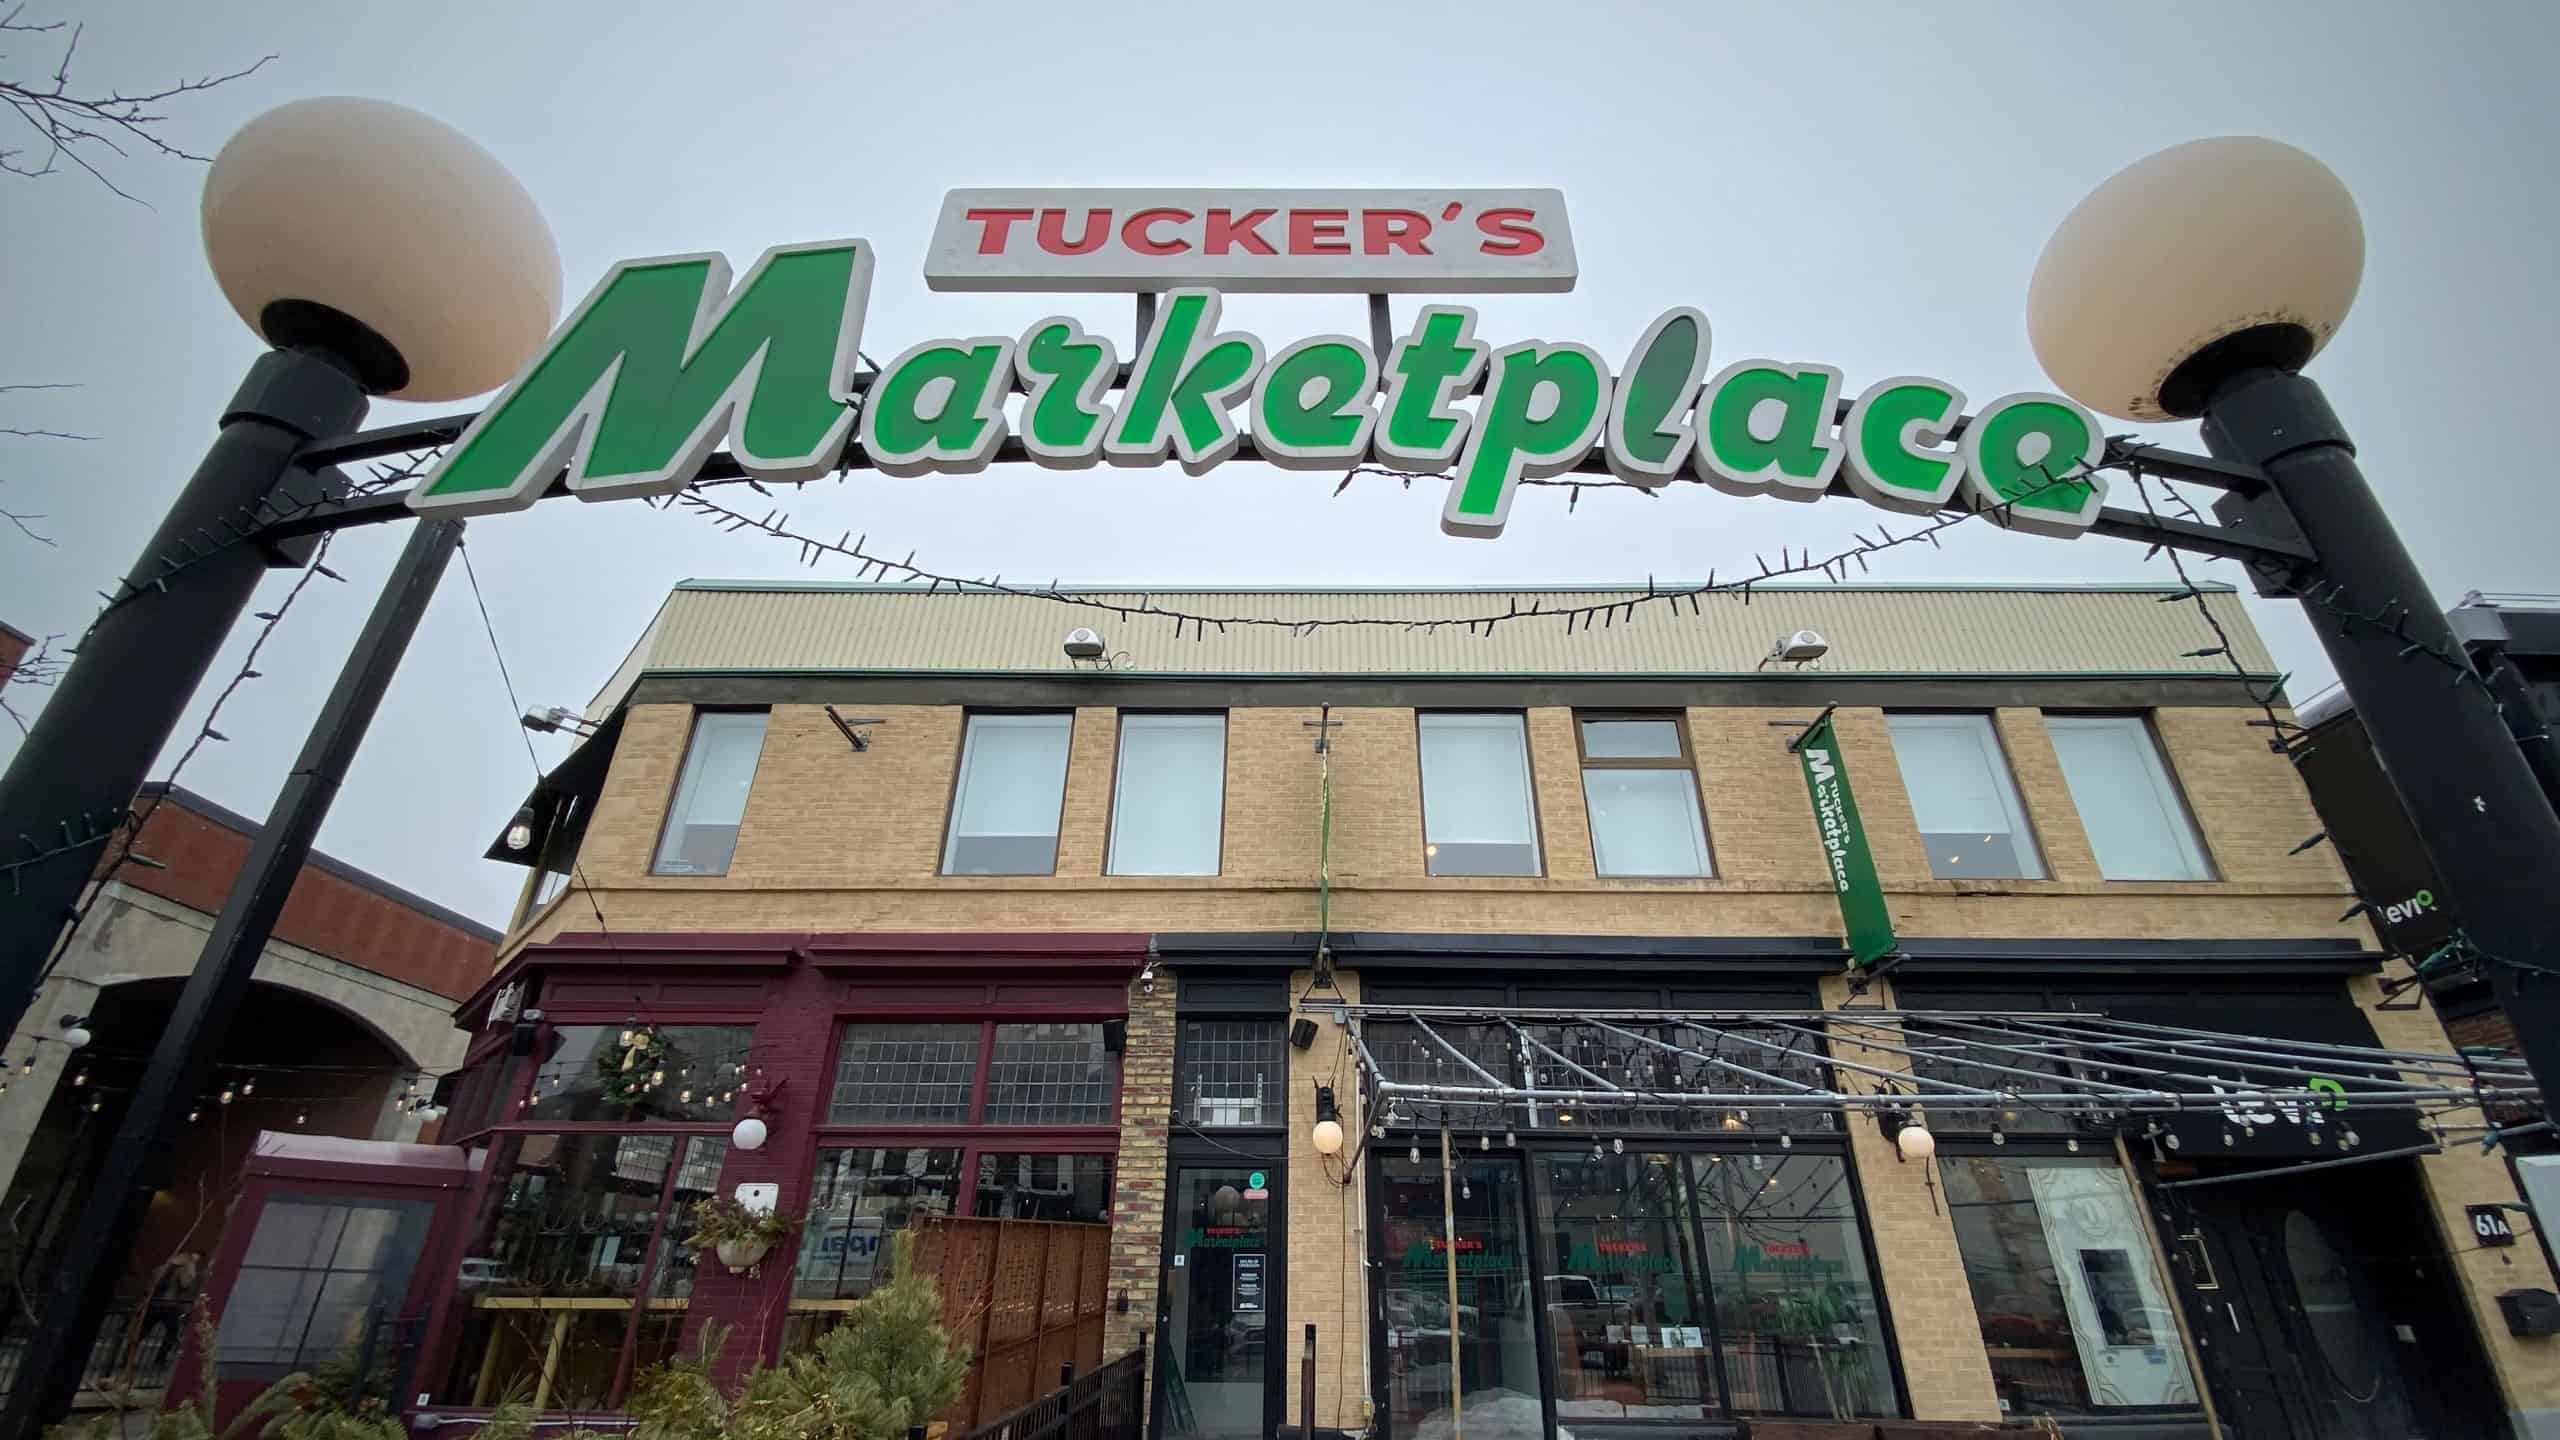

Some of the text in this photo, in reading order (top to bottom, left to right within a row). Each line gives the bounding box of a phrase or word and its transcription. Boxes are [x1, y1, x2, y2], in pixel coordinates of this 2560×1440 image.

[966, 202, 1545, 257] TUCKER'S
[407, 240, 2107, 537] Marketplace
[1805, 749, 1849, 892] Marketplace
[2475, 1214, 2511, 1236] 61A
